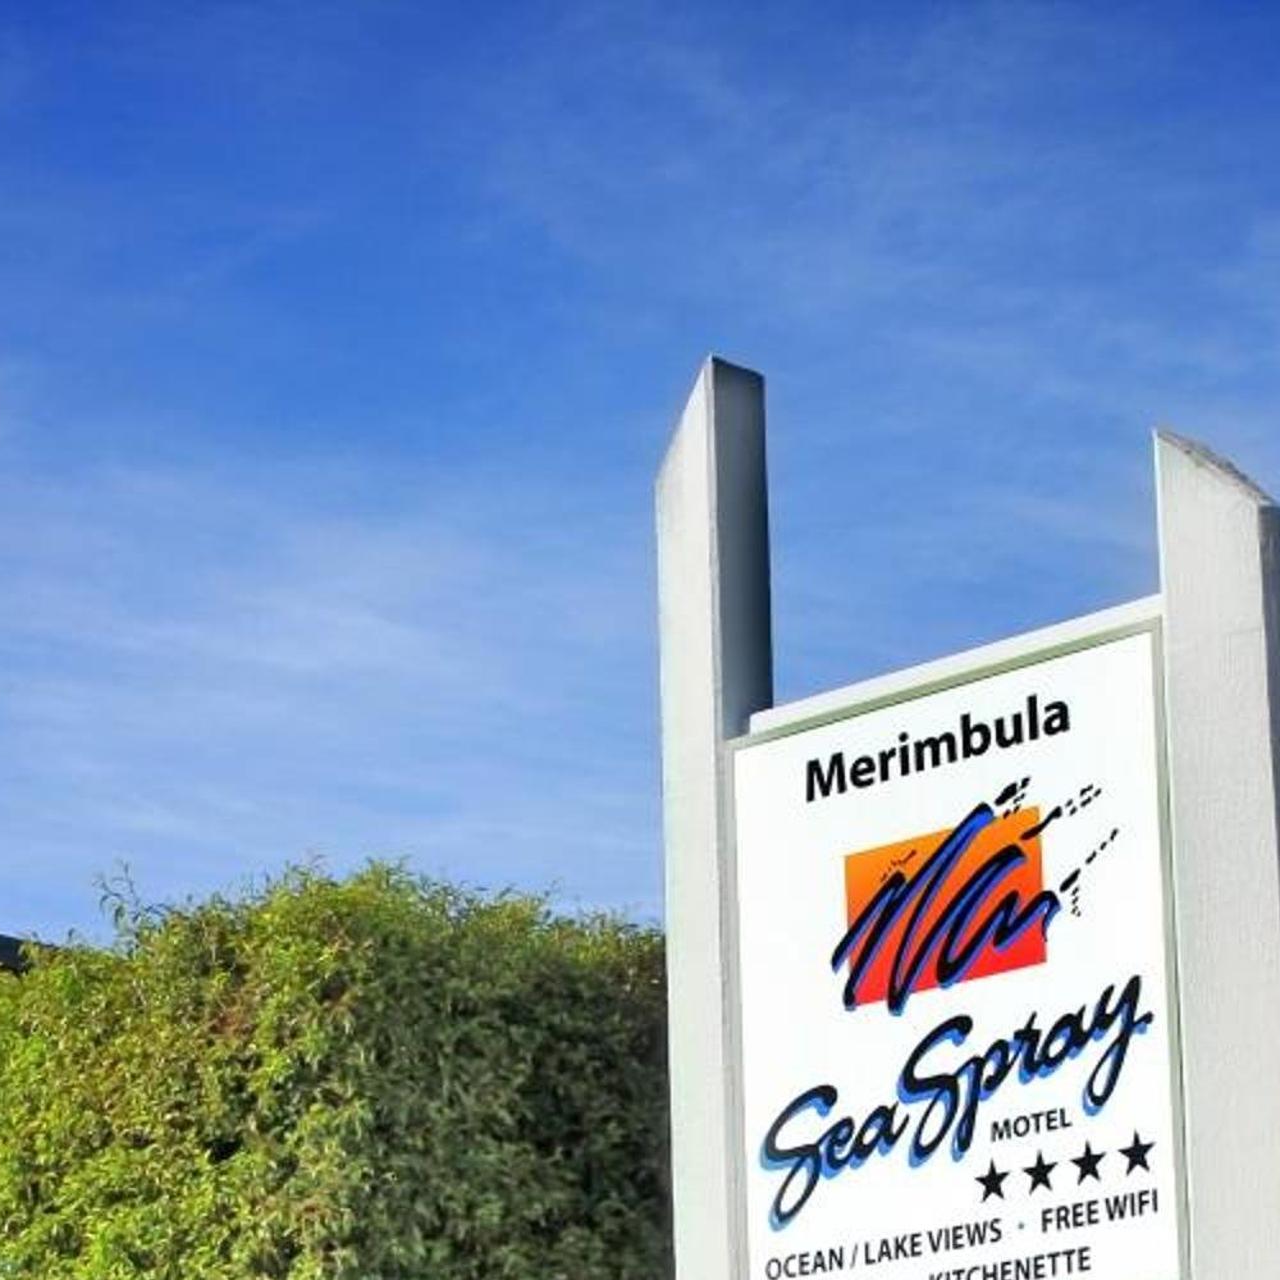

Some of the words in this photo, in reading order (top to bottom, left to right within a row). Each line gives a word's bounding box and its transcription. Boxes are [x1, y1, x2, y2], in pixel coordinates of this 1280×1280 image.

[805, 693, 1071, 803] Merimbula
[759, 1084, 910, 1232] Sea
[895, 974, 1155, 1169] Spray
[990, 1107, 1073, 1143] MOTEL
[765, 1246, 844, 1280] OCEAN
[864, 1232, 923, 1266] LAKE
[926, 1217, 1002, 1254] VIEWS
[1041, 1199, 1100, 1233] FREE
[1104, 1188, 1159, 1222] WIFI
